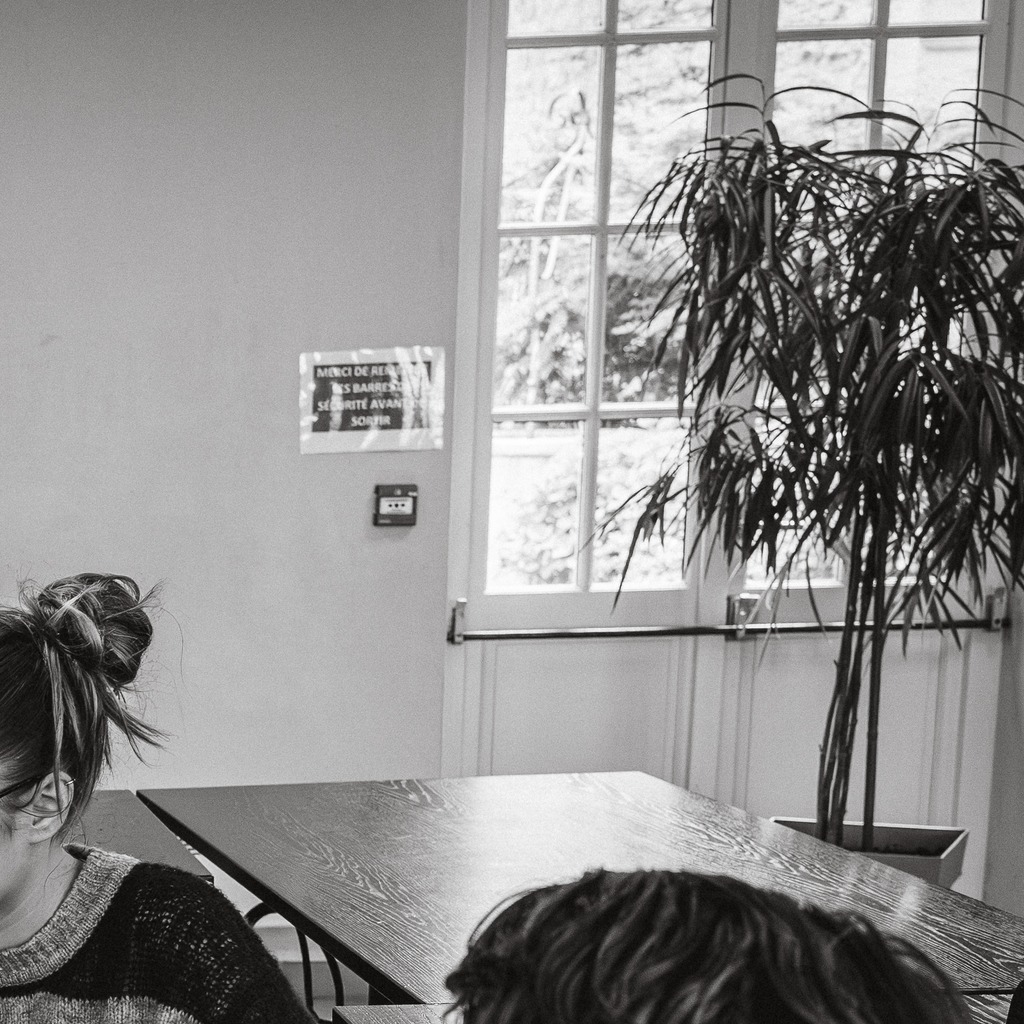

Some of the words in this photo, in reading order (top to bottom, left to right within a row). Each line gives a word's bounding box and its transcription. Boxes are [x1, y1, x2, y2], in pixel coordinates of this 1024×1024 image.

[316, 366, 352, 378] MERCI
[354, 365, 368, 377] DE
[317, 397, 368, 412] SÉRITÉ
[370, 398, 403, 410] AVAN
[351, 415, 391, 427] SORTIR
